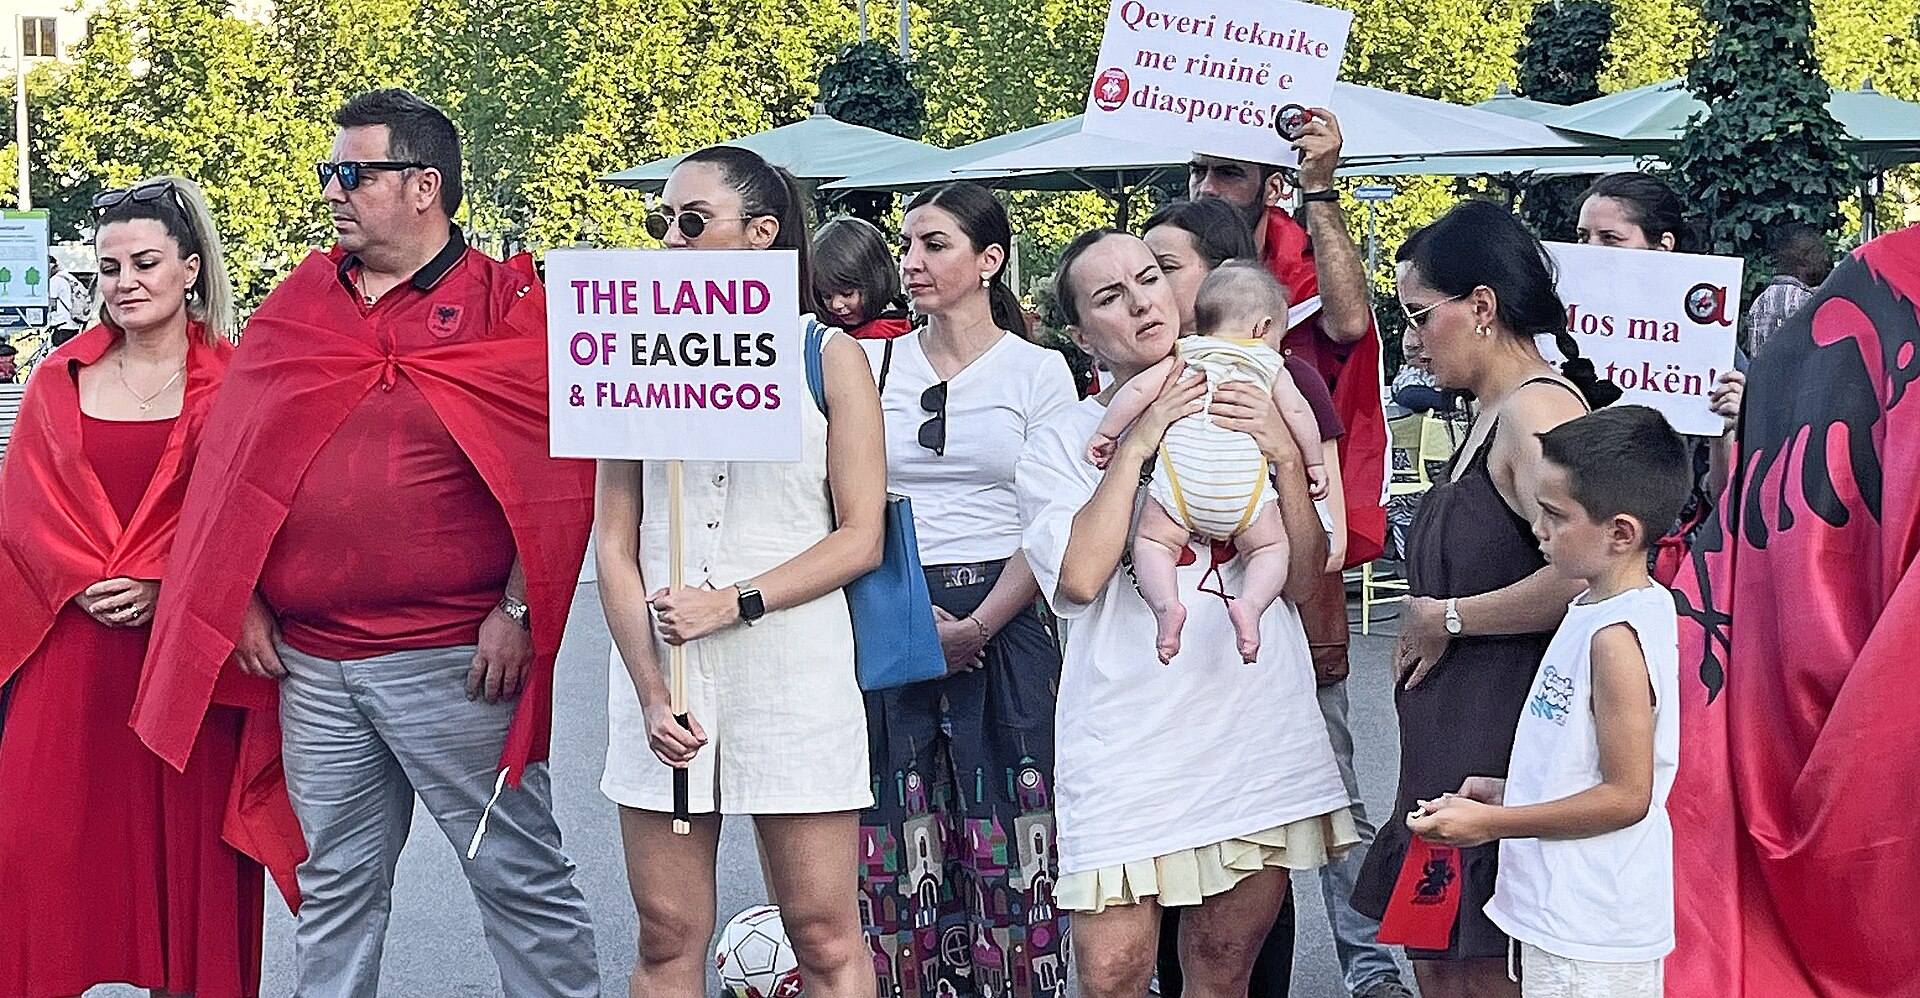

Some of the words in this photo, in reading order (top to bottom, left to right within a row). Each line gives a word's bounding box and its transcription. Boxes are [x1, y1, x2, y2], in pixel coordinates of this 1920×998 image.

[1120, 1, 1216, 37] Qeveri
[1223, 20, 1329, 58] teknike
[1134, 49, 1177, 70] me
[1184, 54, 1272, 85] rininë
[1278, 74, 1293, 89] e
[1132, 85, 1277, 129] diasporës!
[571, 281, 638, 314] THE
[653, 281, 771, 314] LAND
[1627, 318, 1680, 343] ma
[570, 332, 617, 365] OF
[631, 333, 777, 367] EAGLES
[569, 384, 585, 407] &
[596, 383, 780, 410] FLAMINGOS
[1606, 361, 1717, 397] tokën!
